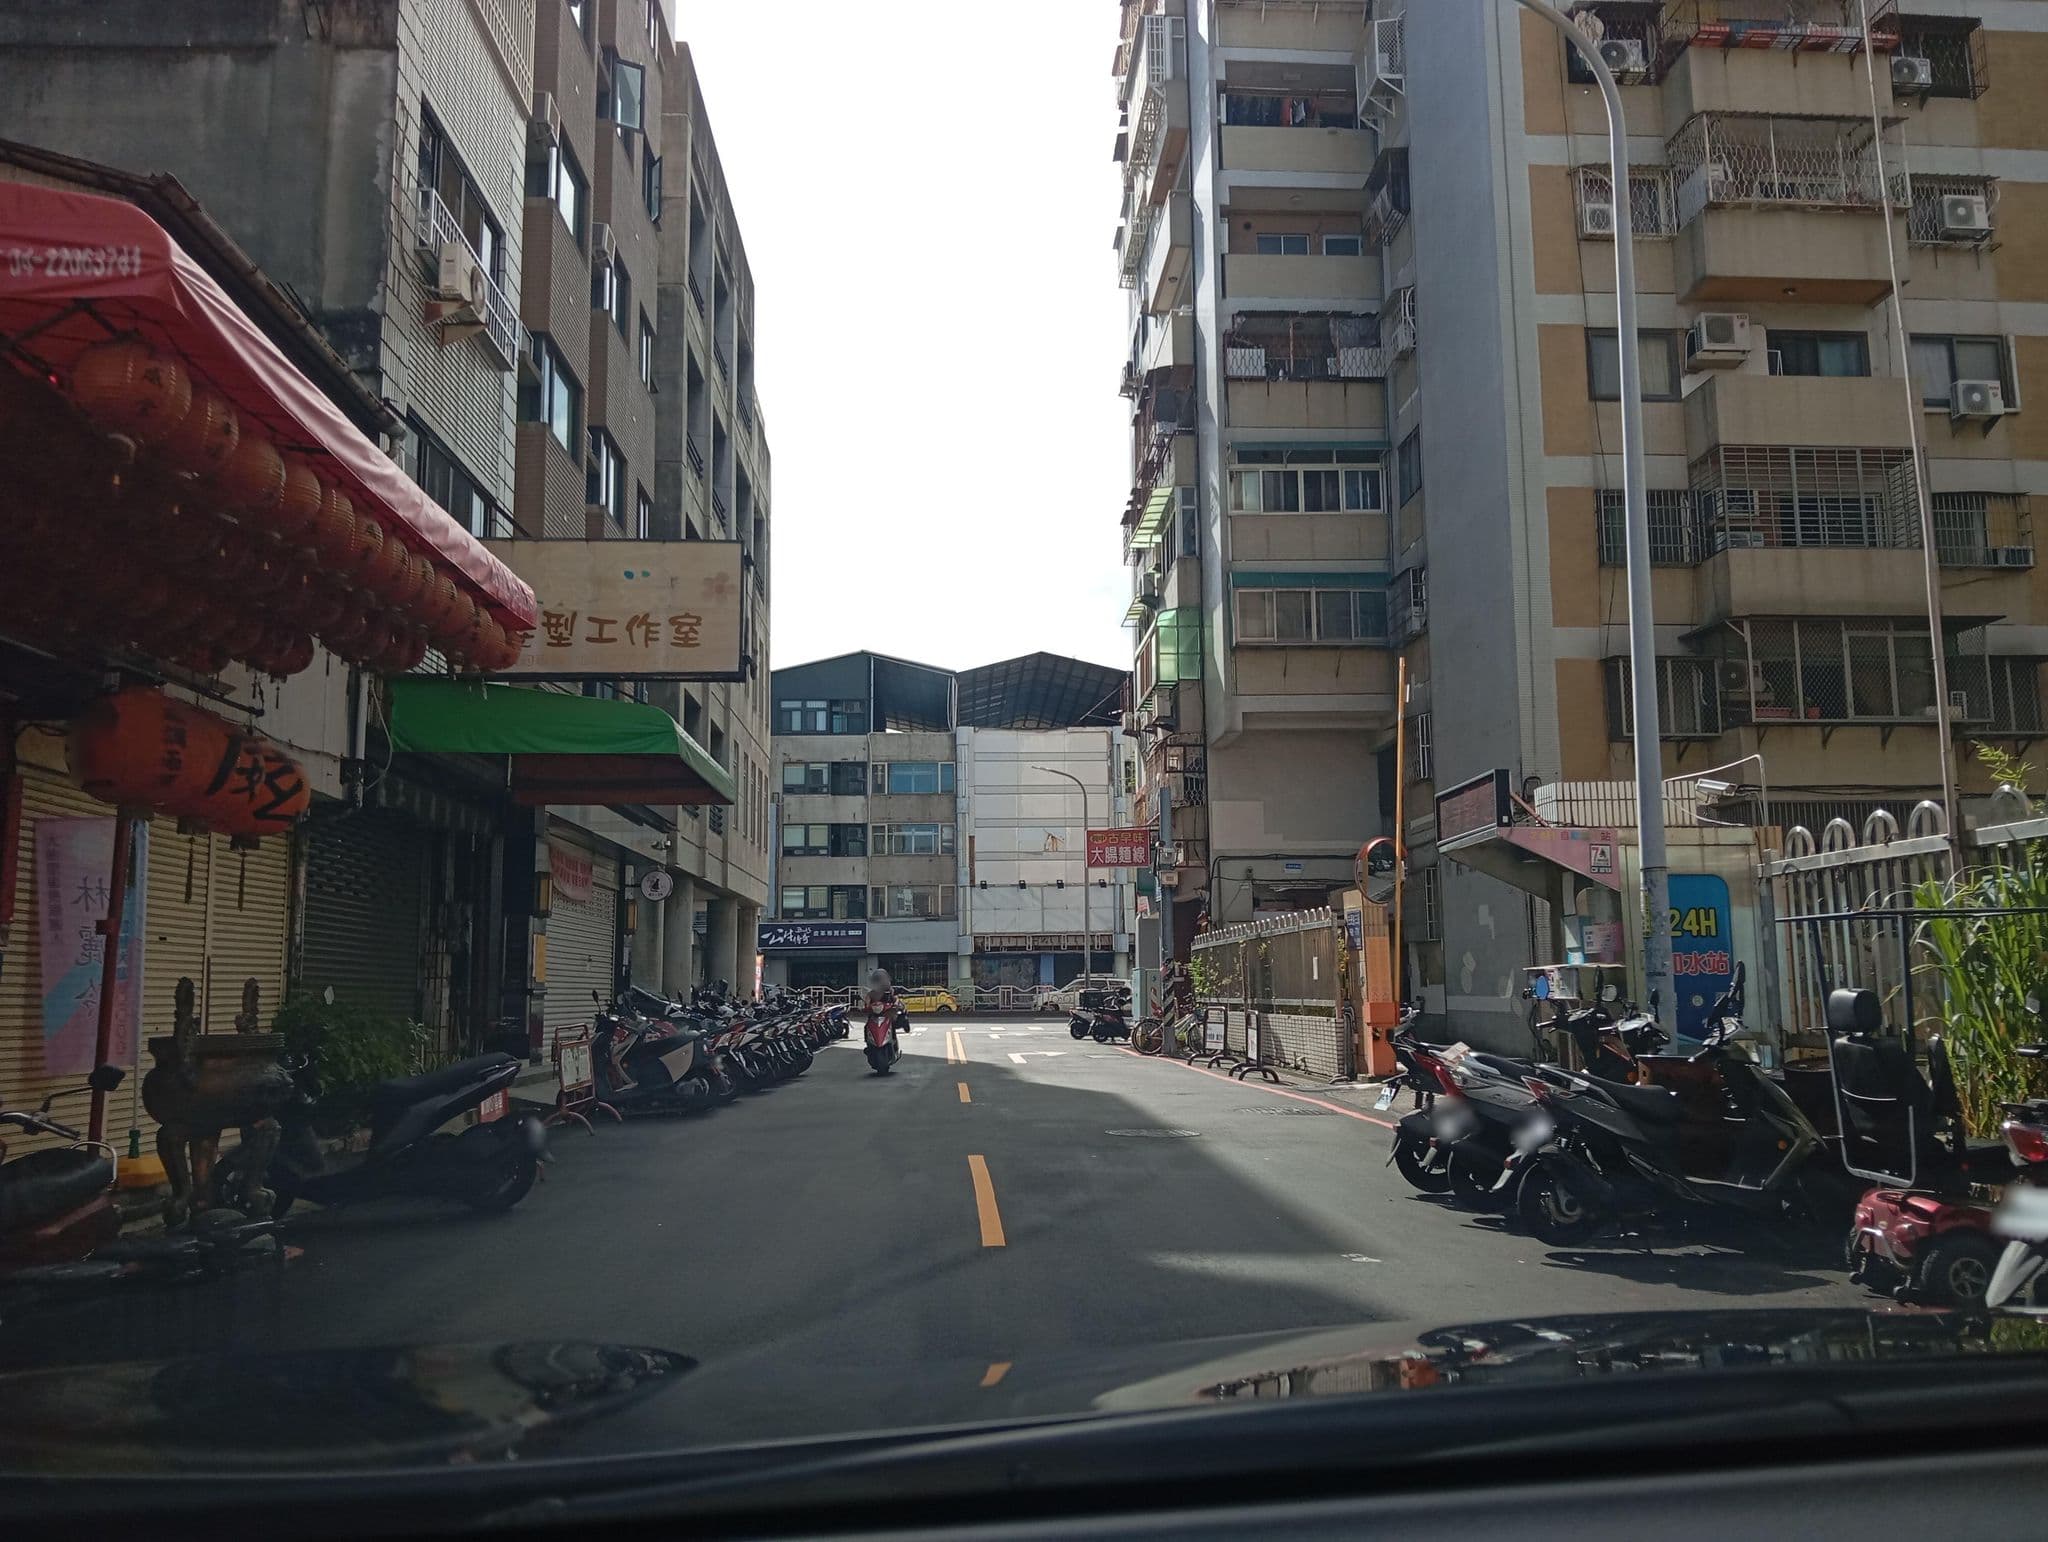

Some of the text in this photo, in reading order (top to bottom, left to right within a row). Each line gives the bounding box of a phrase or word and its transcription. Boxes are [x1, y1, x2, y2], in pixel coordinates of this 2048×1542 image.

[1107, 832, 1145, 844] 古早味
[1091, 846, 1145, 864] 大腸麵線
[1669, 907, 1717, 937] 24H
